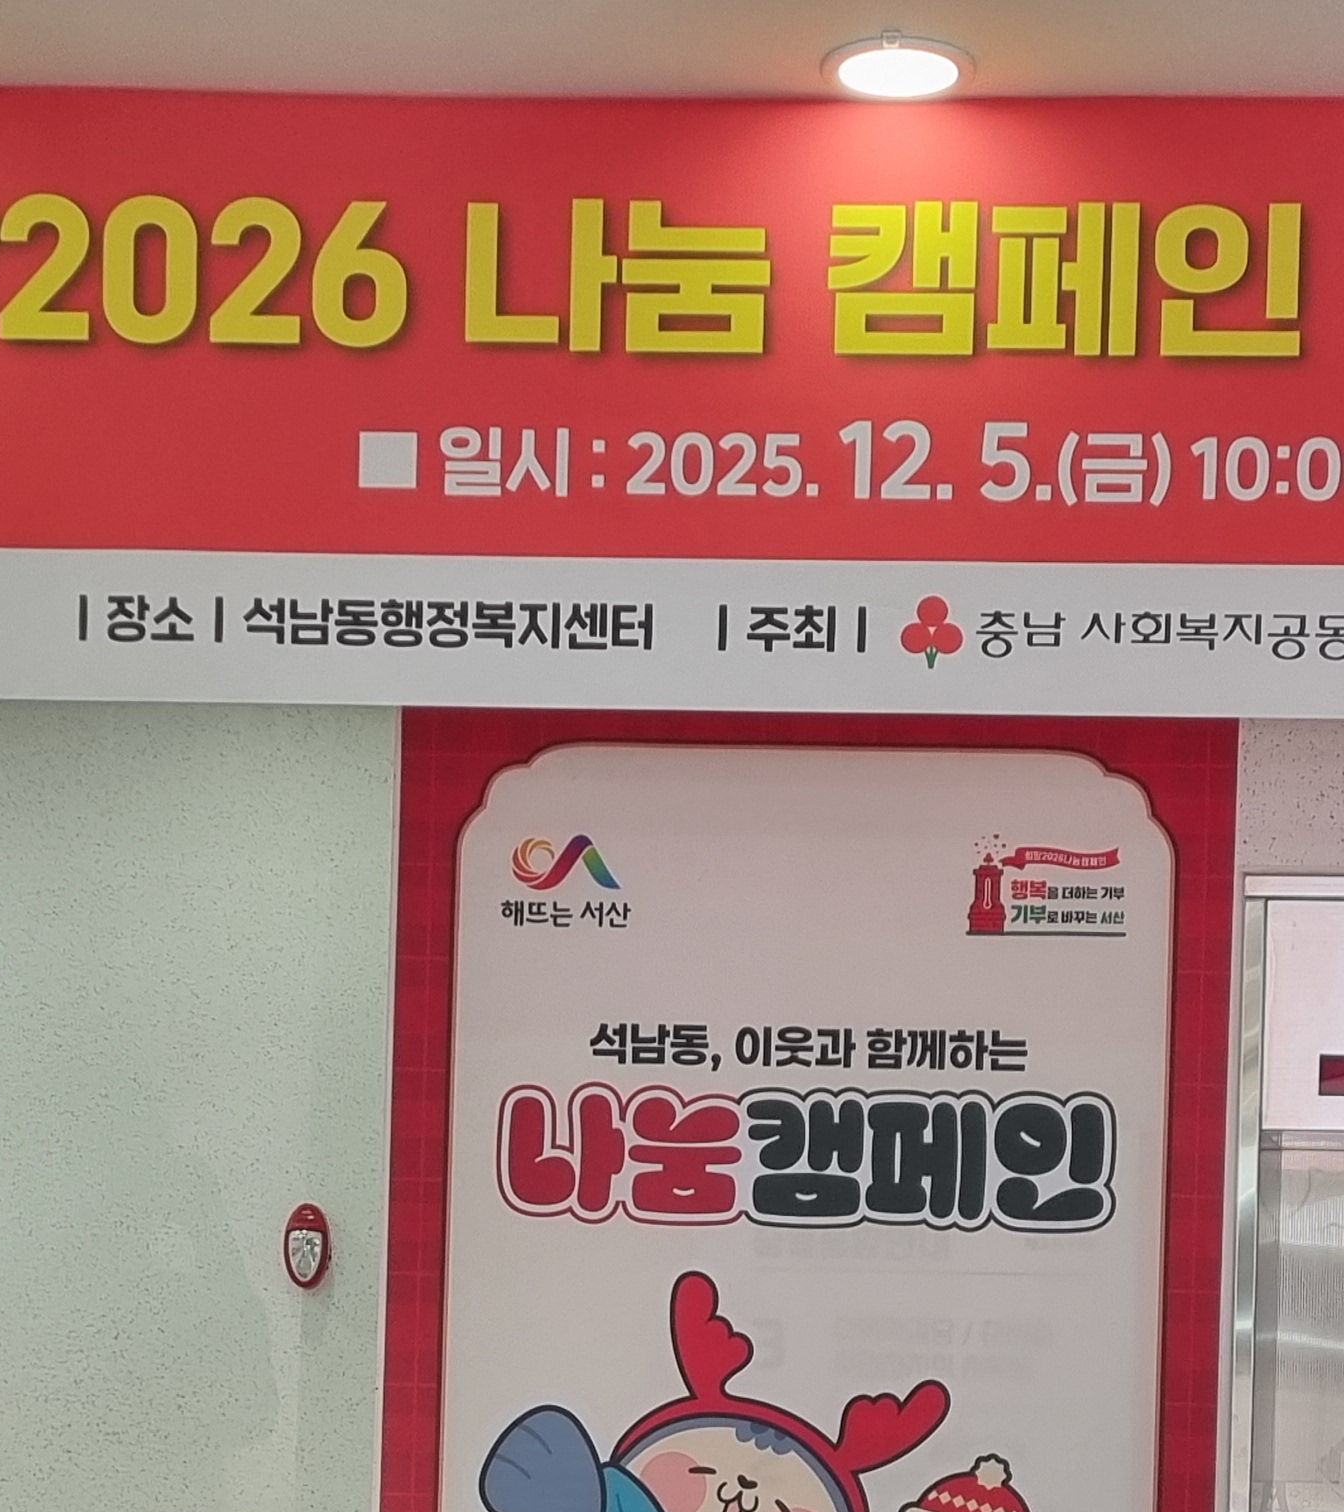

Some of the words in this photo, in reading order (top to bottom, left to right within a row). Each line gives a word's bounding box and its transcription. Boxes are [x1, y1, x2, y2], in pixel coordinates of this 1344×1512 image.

[465, 198, 771, 355] 나눔
[827, 199, 1304, 359] 캠페인
[439, 426, 570, 498] 일시
[626, 431, 820, 498] 2025.
[839, 419, 954, 500] 12.
[107, 594, 195, 643] 장소
[243, 597, 654, 651] 석남동행정복지센터
[746, 604, 837, 653] 주최
[975, 610, 1066, 659] 충남
[500, 899, 573, 928] 해뜨는
[579, 901, 632, 928] 서산
[1010, 904, 1058, 925] 기부로
[1061, 910, 1098, 924] 바꾸는
[1100, 911, 1125, 925] 서산
[1011, 879, 1058, 900] 행복을
[1062, 886, 1098, 900] 더하는
[1100, 886, 1125, 900] 기부
[589, 1022, 722, 1072] 석남동,
[735, 1026, 857, 1069] 이웃과
[866, 1027, 1028, 1072] 함께하는
[500, 1085, 1114, 1229] 나눔캠페인
